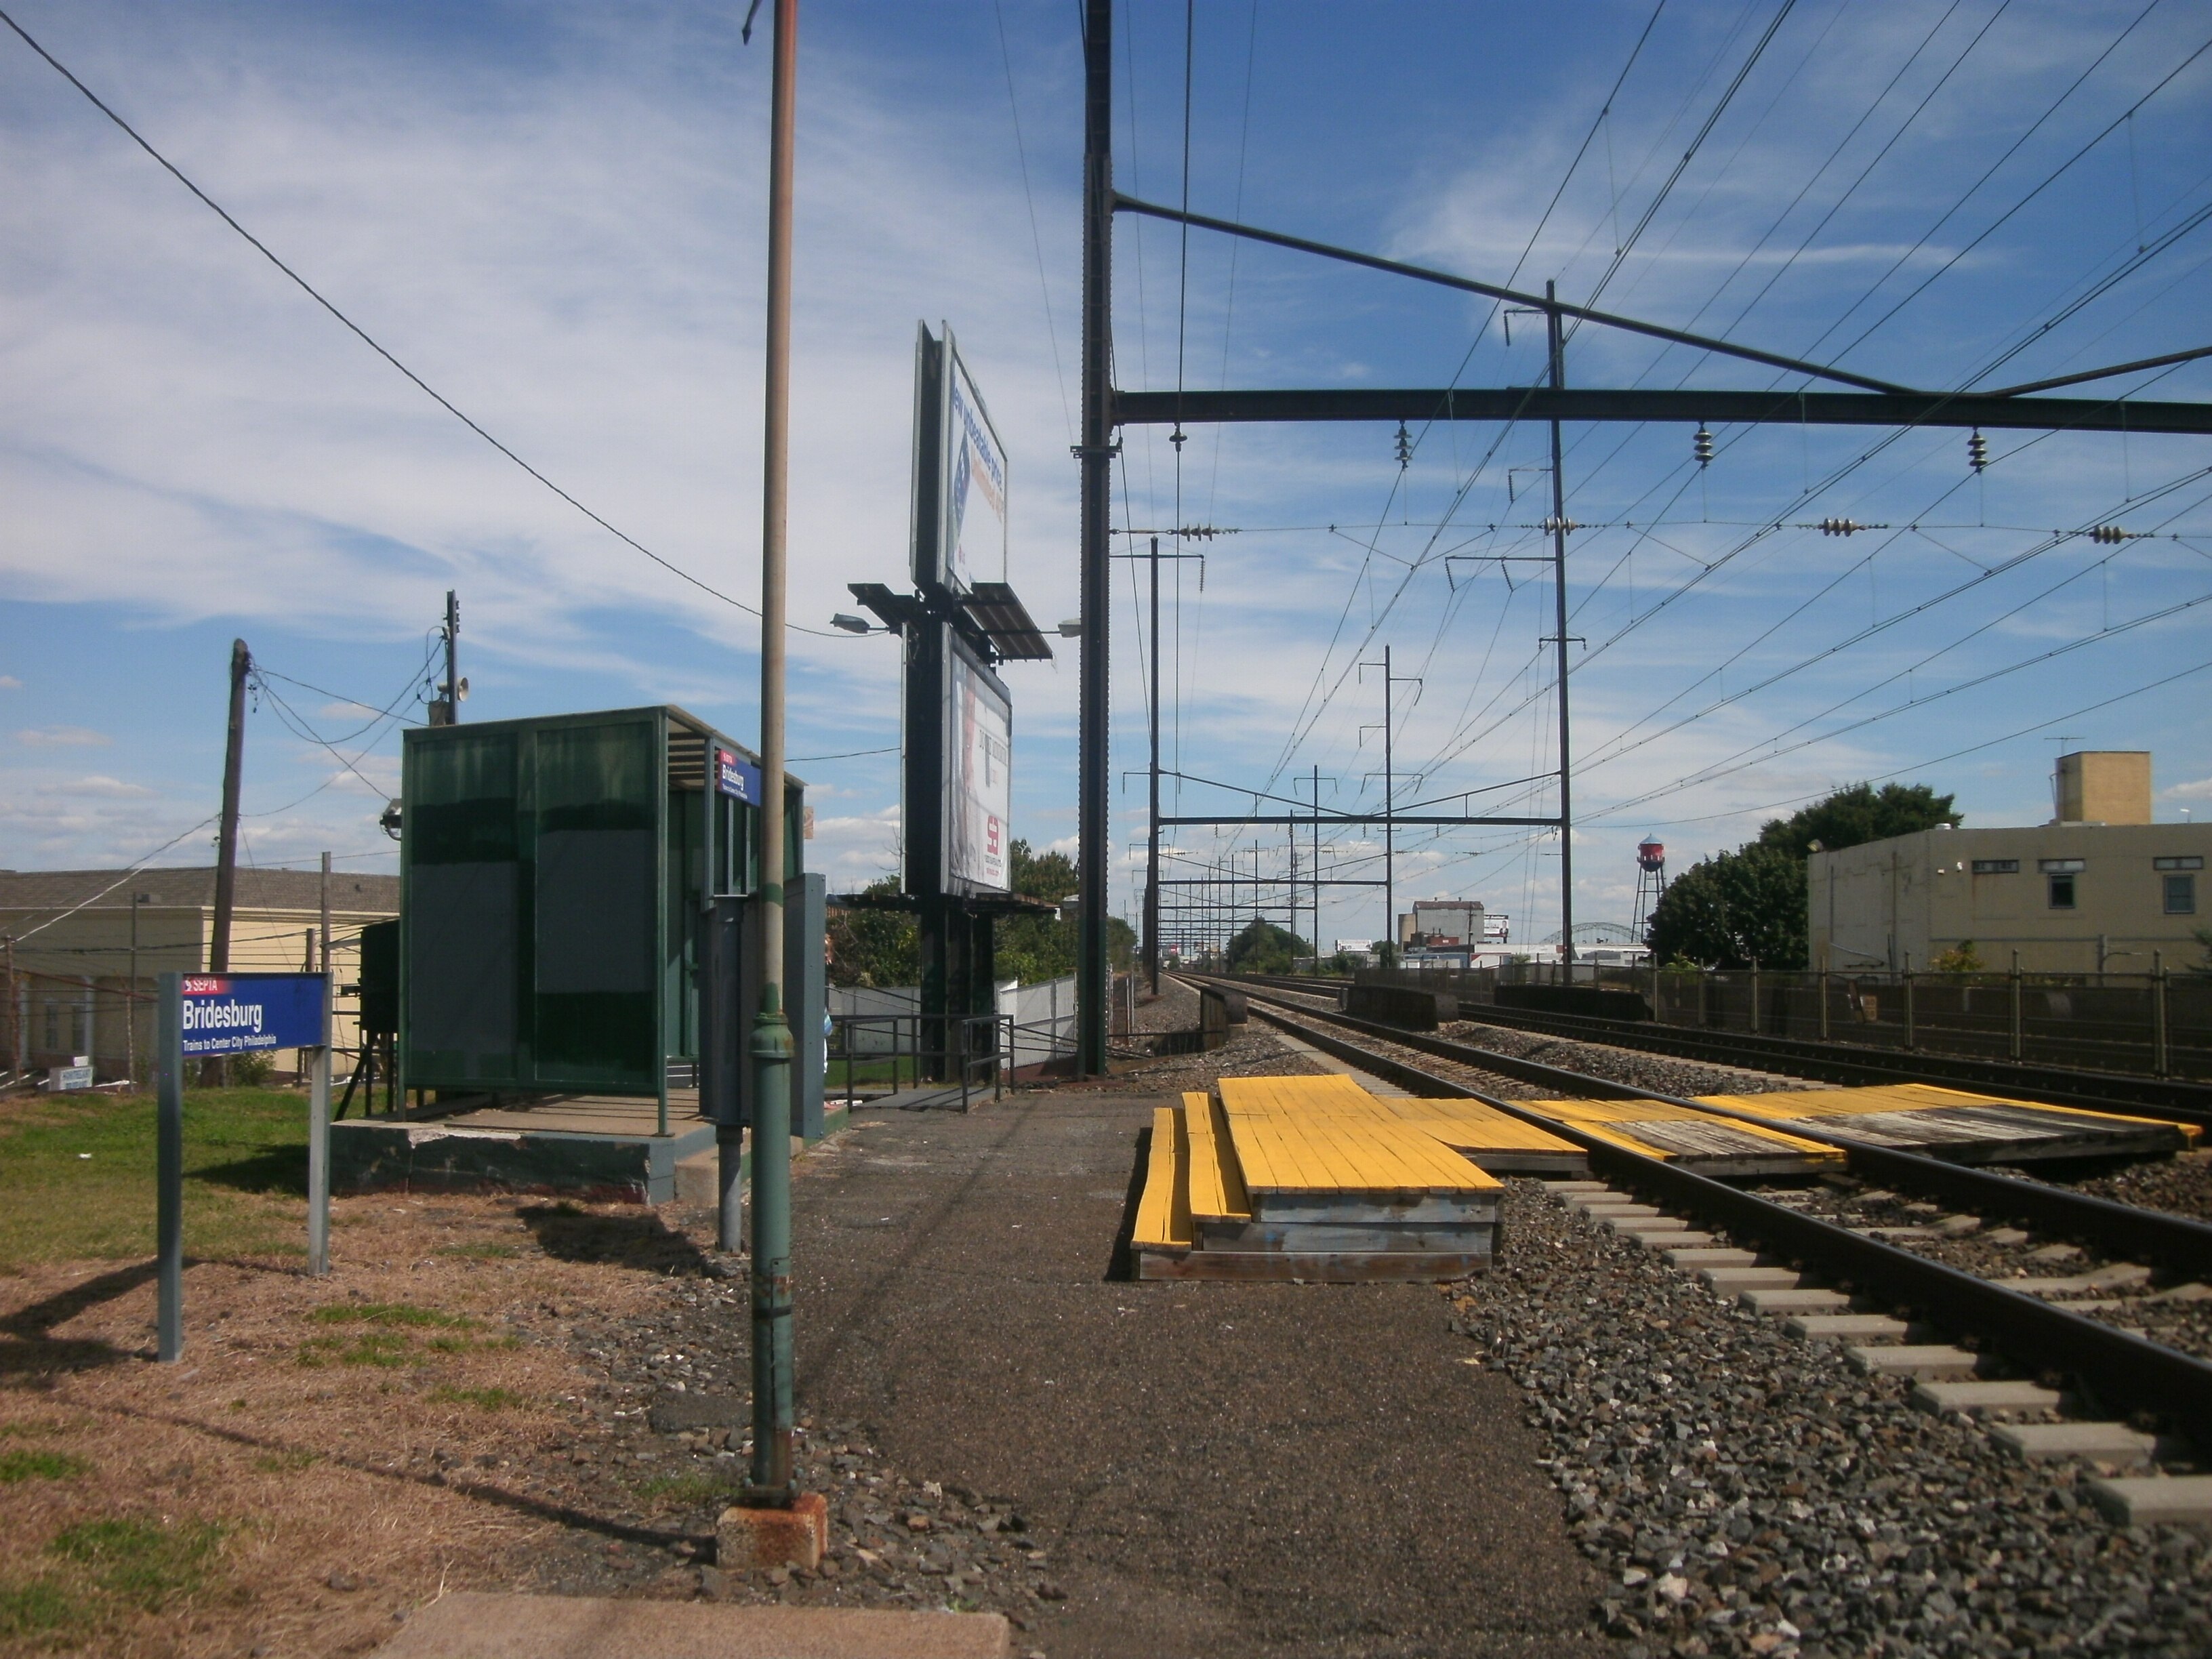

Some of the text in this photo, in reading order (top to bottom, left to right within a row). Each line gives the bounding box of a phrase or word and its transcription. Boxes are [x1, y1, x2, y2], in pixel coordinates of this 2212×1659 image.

[193, 977, 218, 991] SEPTA
[183, 999, 262, 1033] Bridesburg
[183, 1034, 276, 1051] Trains to Center City Philadelphia
